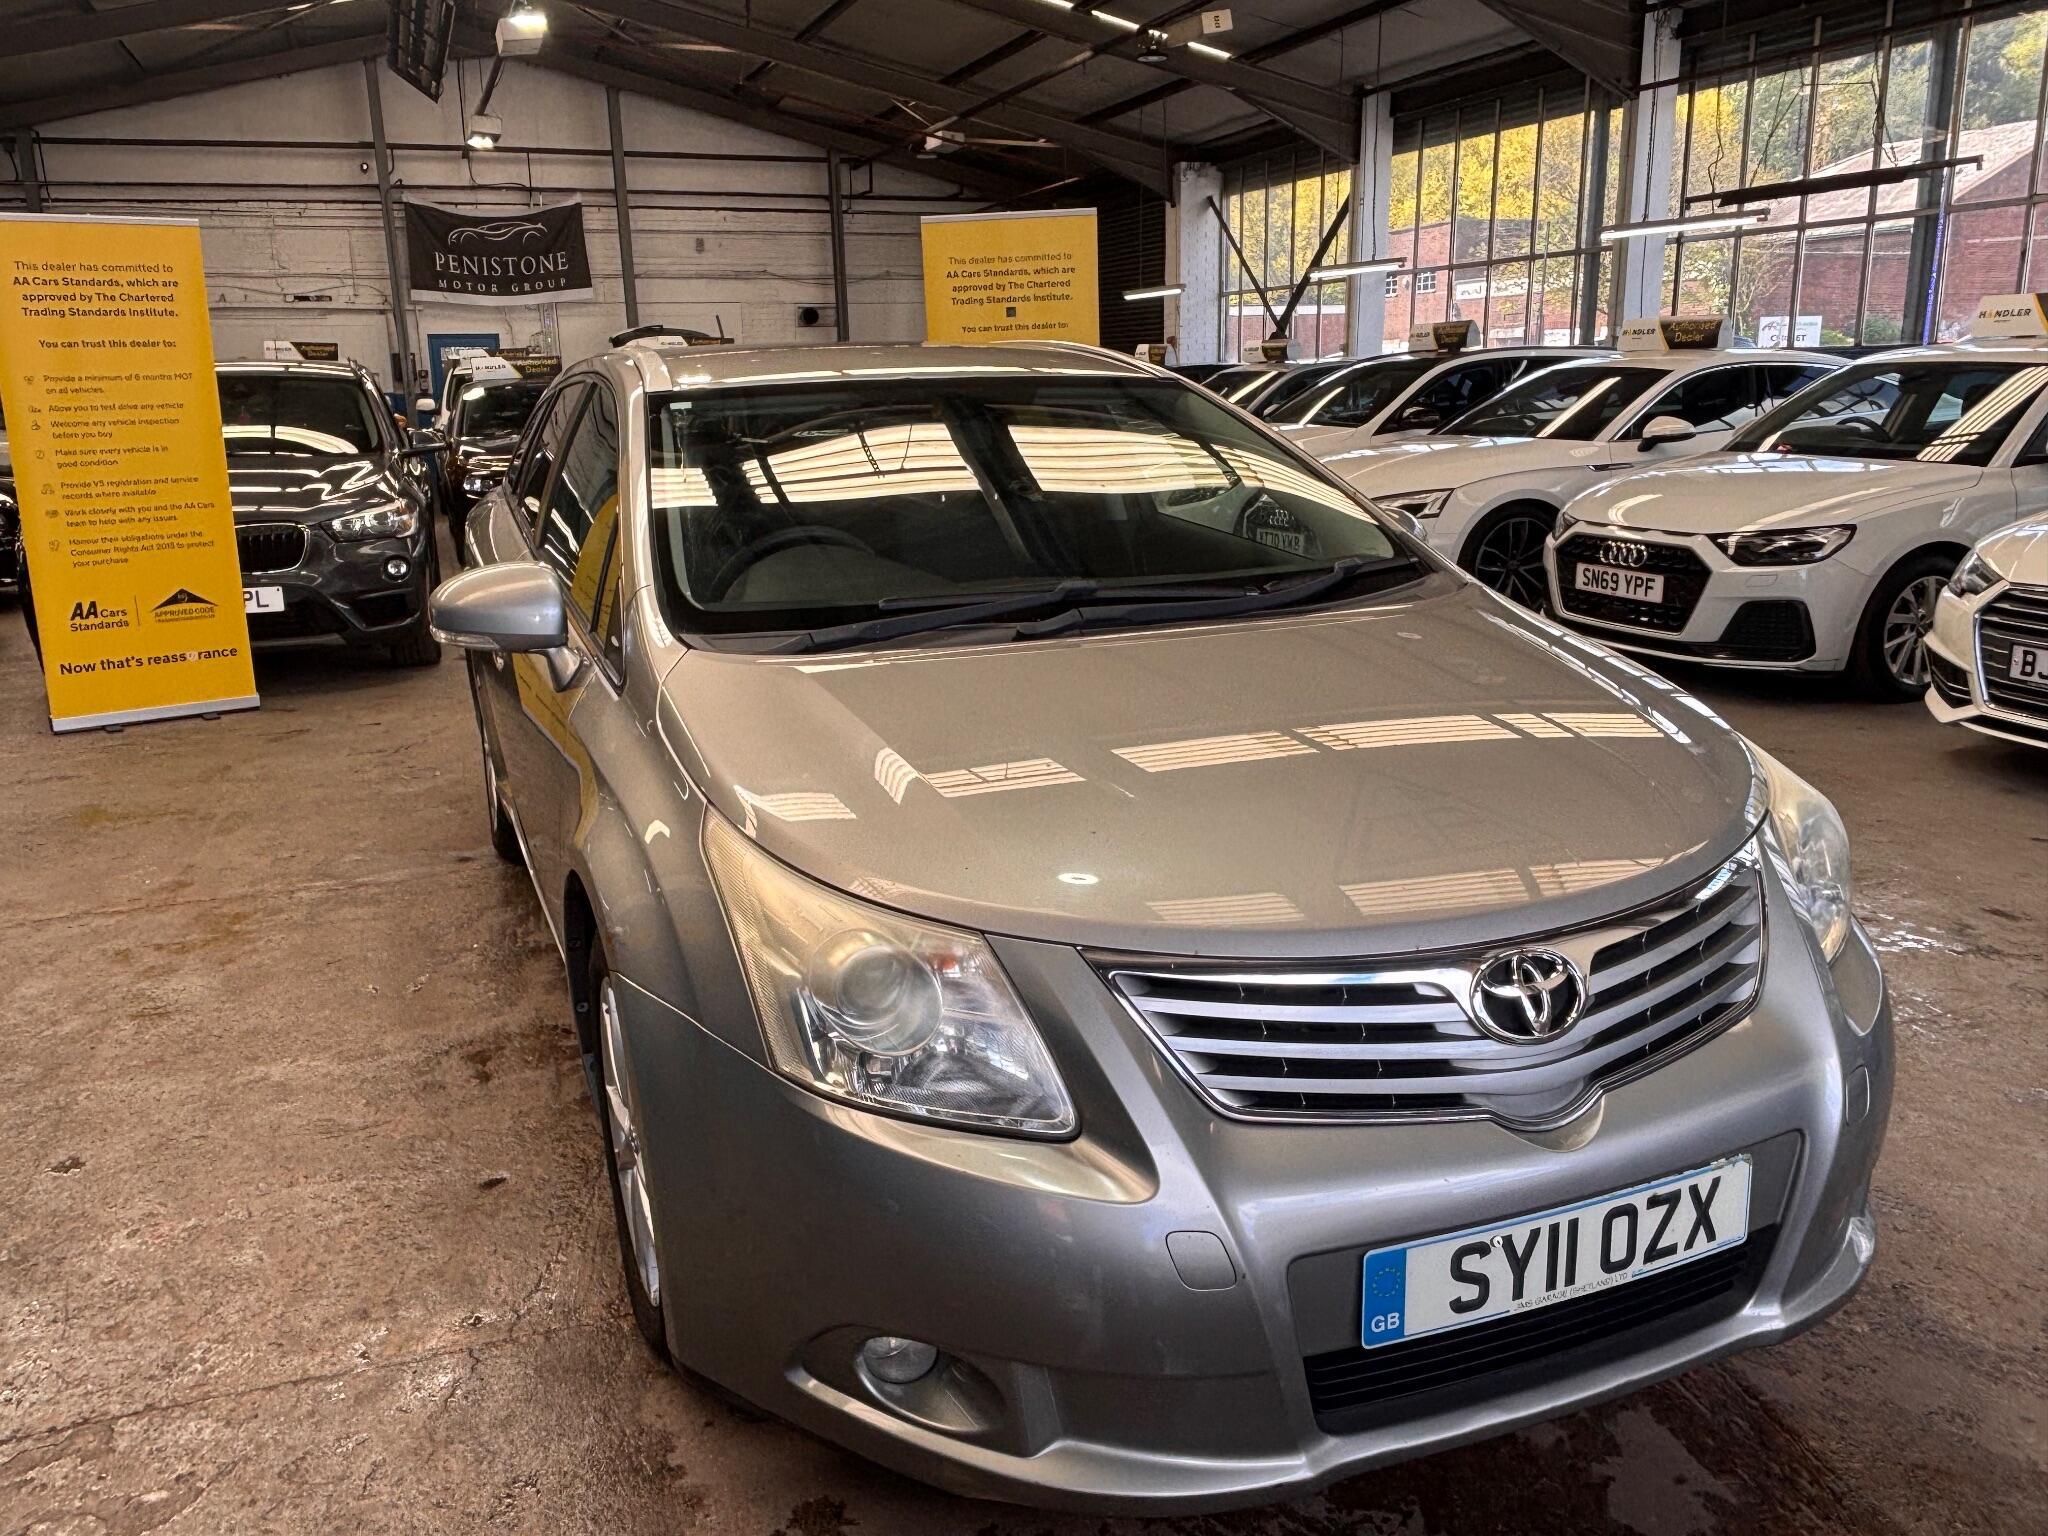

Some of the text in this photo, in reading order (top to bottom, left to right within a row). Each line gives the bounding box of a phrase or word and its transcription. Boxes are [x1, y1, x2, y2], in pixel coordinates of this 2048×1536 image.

[435, 251, 568, 276] PENISTONE
[948, 257, 966, 265] This
[969, 256, 995, 265] dealer
[998, 255, 1012, 263] has
[1015, 253, 1062, 262] committed
[14, 261, 173, 272] This dealer has committed to
[947, 271, 959, 279] AA
[961, 270, 981, 278] Cars
[1033, 267, 1059, 275] which
[13, 277, 30, 285] AA
[32, 277, 59, 286] Cars
[126, 278, 158, 287] which
[162, 280, 178, 288] are
[438, 277, 566, 292] MOTOR GROUP
[952, 279, 1071, 292] approved by The Chartered
[22, 292, 174, 303] approved by The Chartered
[952, 297, 984, 306] Trading
[986, 294, 1031, 304] Standards
[21, 307, 65, 318] Trading
[68, 307, 126, 317] Standards
[962, 325, 976, 333] You
[994, 324, 1012, 332] trust
[1015, 323, 1029, 331] this
[1032, 322, 1056, 330] dealer
[38, 339, 58, 348] You
[82, 340, 107, 348] trust
[109, 339, 127, 348] this
[130, 339, 160, 348] dealer
[1582, 567, 1656, 597] SN69 YPF
[70, 601, 128, 621] AA Cars
[70, 619, 129, 632] Standards
[60, 662, 96, 675] Now
[100, 656, 144, 671] that's
[1449, 1175, 1722, 1314] SY11 OZX
[1371, 1311, 1400, 1333] GB
